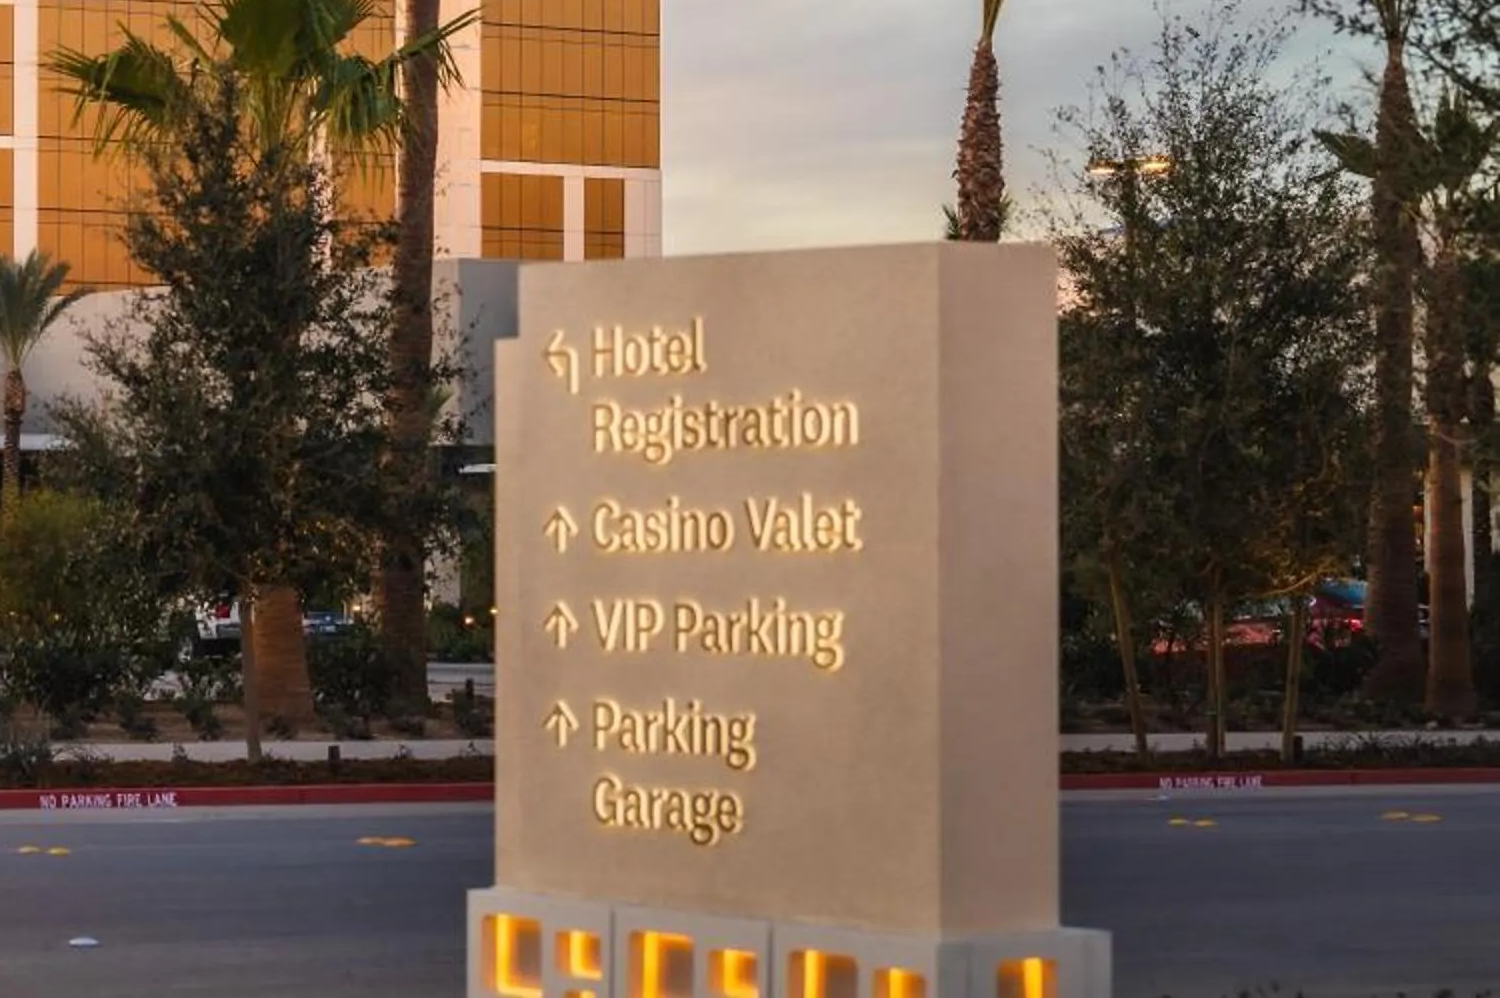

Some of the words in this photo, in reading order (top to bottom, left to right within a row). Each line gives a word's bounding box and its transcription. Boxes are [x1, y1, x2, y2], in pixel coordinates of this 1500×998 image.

[591, 316, 707, 377] Hotel
[591, 389, 859, 465] Registration
[593, 497, 735, 552] Casino
[744, 491, 863, 551] Valet
[593, 597, 664, 652] VIP
[674, 596, 844, 672] Parking
[593, 697, 756, 771] Parking
[40, 793, 56, 808] NO
[61, 793, 112, 808] PARKING
[116, 793, 141, 808] FIRE
[147, 791, 177, 807] LANE
[593, 772, 742, 846] Garage
